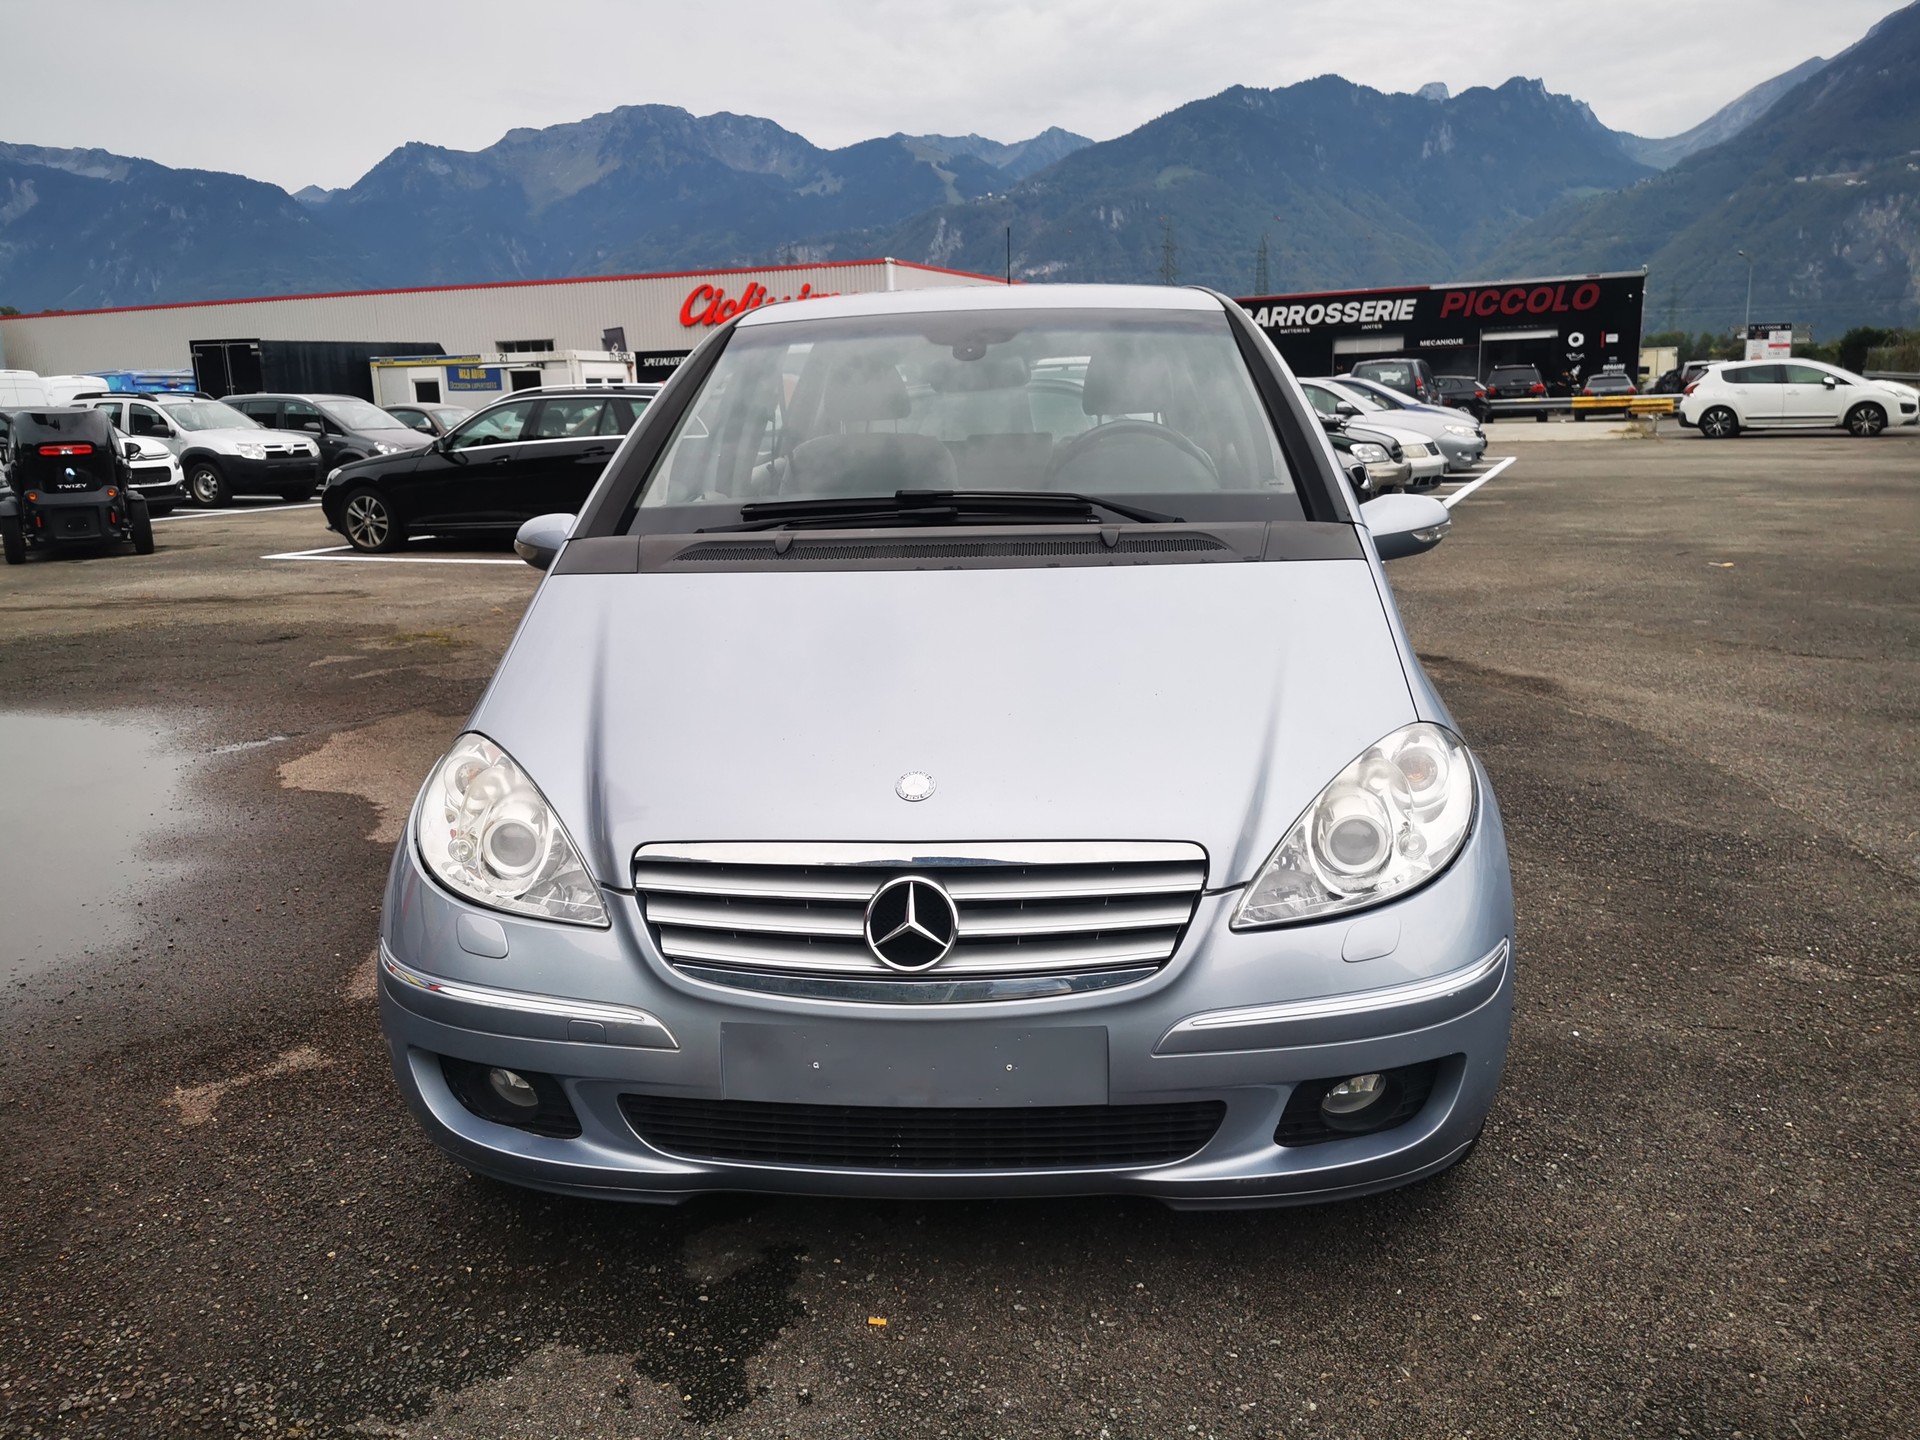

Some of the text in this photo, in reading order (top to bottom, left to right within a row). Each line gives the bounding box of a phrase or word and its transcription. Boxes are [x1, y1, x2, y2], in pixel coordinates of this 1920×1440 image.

[680, 282, 859, 327] Cicli
[1440, 283, 1601, 319] PICCOLO
[1280, 327, 1310, 335] BATTERIES
[1419, 337, 1464, 347] MECANIQUE
[499, 353, 508, 362] 21
